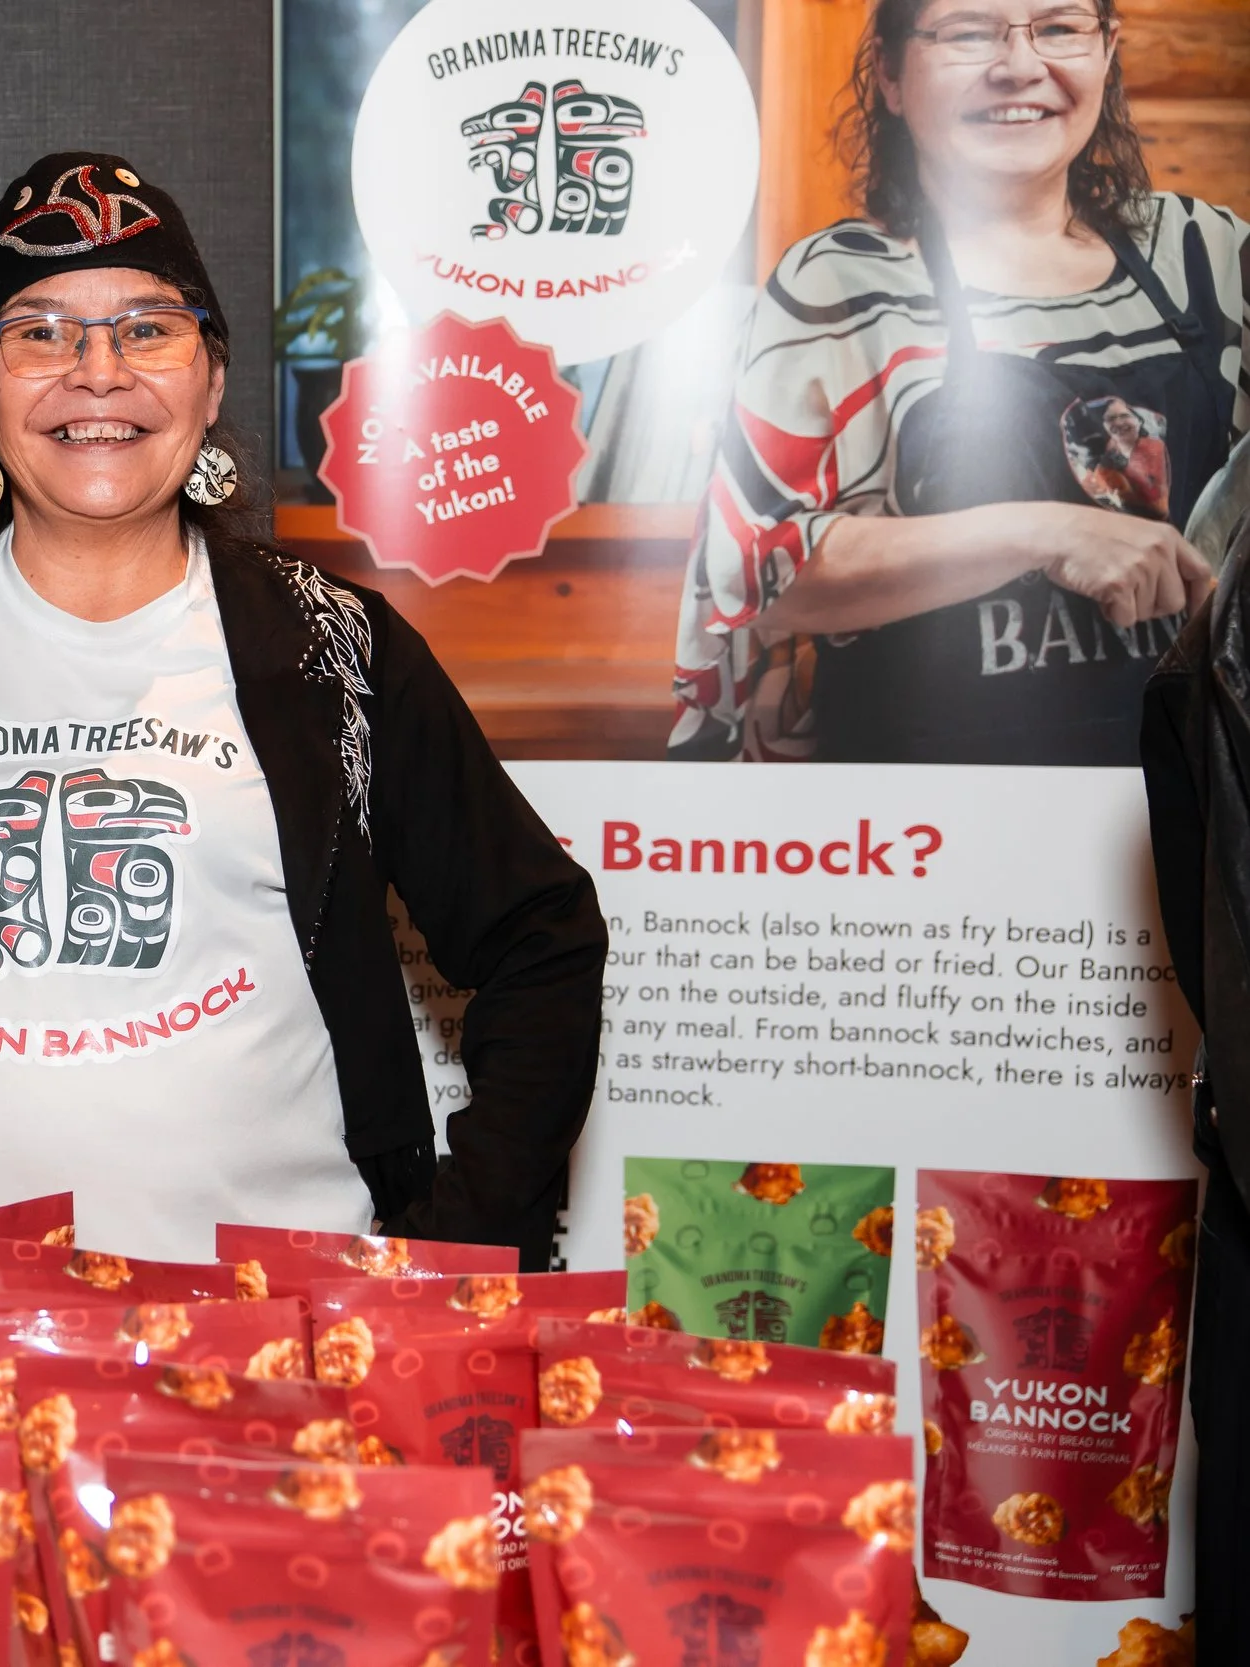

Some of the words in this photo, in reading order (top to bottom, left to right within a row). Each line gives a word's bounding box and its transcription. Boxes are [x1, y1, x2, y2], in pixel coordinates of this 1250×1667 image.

[428, 29, 546, 80] GRANDMA
[552, 28, 684, 76] TREESAW'S
[403, 438, 426, 463] A
[431, 419, 500, 453] taste
[418, 460, 447, 491] of
[453, 451, 500, 481] the
[415, 476, 516, 525] Yukon!
[69, 718, 238, 769] TREESAW'S
[602, 819, 943, 878] Bannock?
[643, 911, 750, 936] Bannock
[762, 911, 819, 941] (also
[831, 913, 912, 938] known
[923, 922, 950, 939] as
[961, 916, 995, 946] fry
[1006, 918, 1093, 949] bread)
[1108, 923, 1126, 945] is
[1137, 929, 1150, 945] a
[656, 946, 700, 967] that
[710, 951, 753, 969] can
[766, 949, 797, 970] be
[808, 948, 885, 972] baked
[896, 956, 922, 973] or
[933, 950, 1002, 977] fried.
[1016, 956, 1068, 979] Our
[1080, 958, 1177, 982] Bannoc
[43, 968, 255, 1057] BANNOCK
[639, 985, 669, 1001] on
[680, 981, 717, 1003] the
[729, 982, 827, 1010] outside,
[838, 985, 886, 1008] and
[898, 985, 961, 1015] fluffy
[971, 995, 1004, 1012] on
[1015, 991, 1055, 1015] the
[1068, 993, 1147, 1017] inside
[624, 1019, 665, 1041] any
[677, 1016, 743, 1040] meal.
[756, 1017, 818, 1041] From
[831, 1019, 939, 1044] bannock
[950, 1024, 1112, 1056] sandwiches,
[1125, 1029, 1173, 1053] and
[616, 1053, 642, 1069] as
[653, 1052, 783, 1079] strawberry
[794, 1053, 983, 1085] short-bannock,
[996, 1063, 1062, 1085] there
[1075, 1065, 1094, 1087] is
[1105, 1066, 1187, 1094] always
[608, 1083, 722, 1106] bannock.
[984, 1377, 1108, 1406] YUKON
[970, 1400, 1132, 1433] BANNOCK
[985, 1427, 1035, 1443] ORIGINAL
[1038, 1432, 1057, 1444] FRY
[1059, 1435, 1094, 1448] BREAD
[1096, 1438, 1115, 1448] MIX
[1031, 1448, 1055, 1460] PAIN
[1058, 1450, 1079, 1463] FRIT
[1081, 1452, 1132, 1464] ORIGINAL
